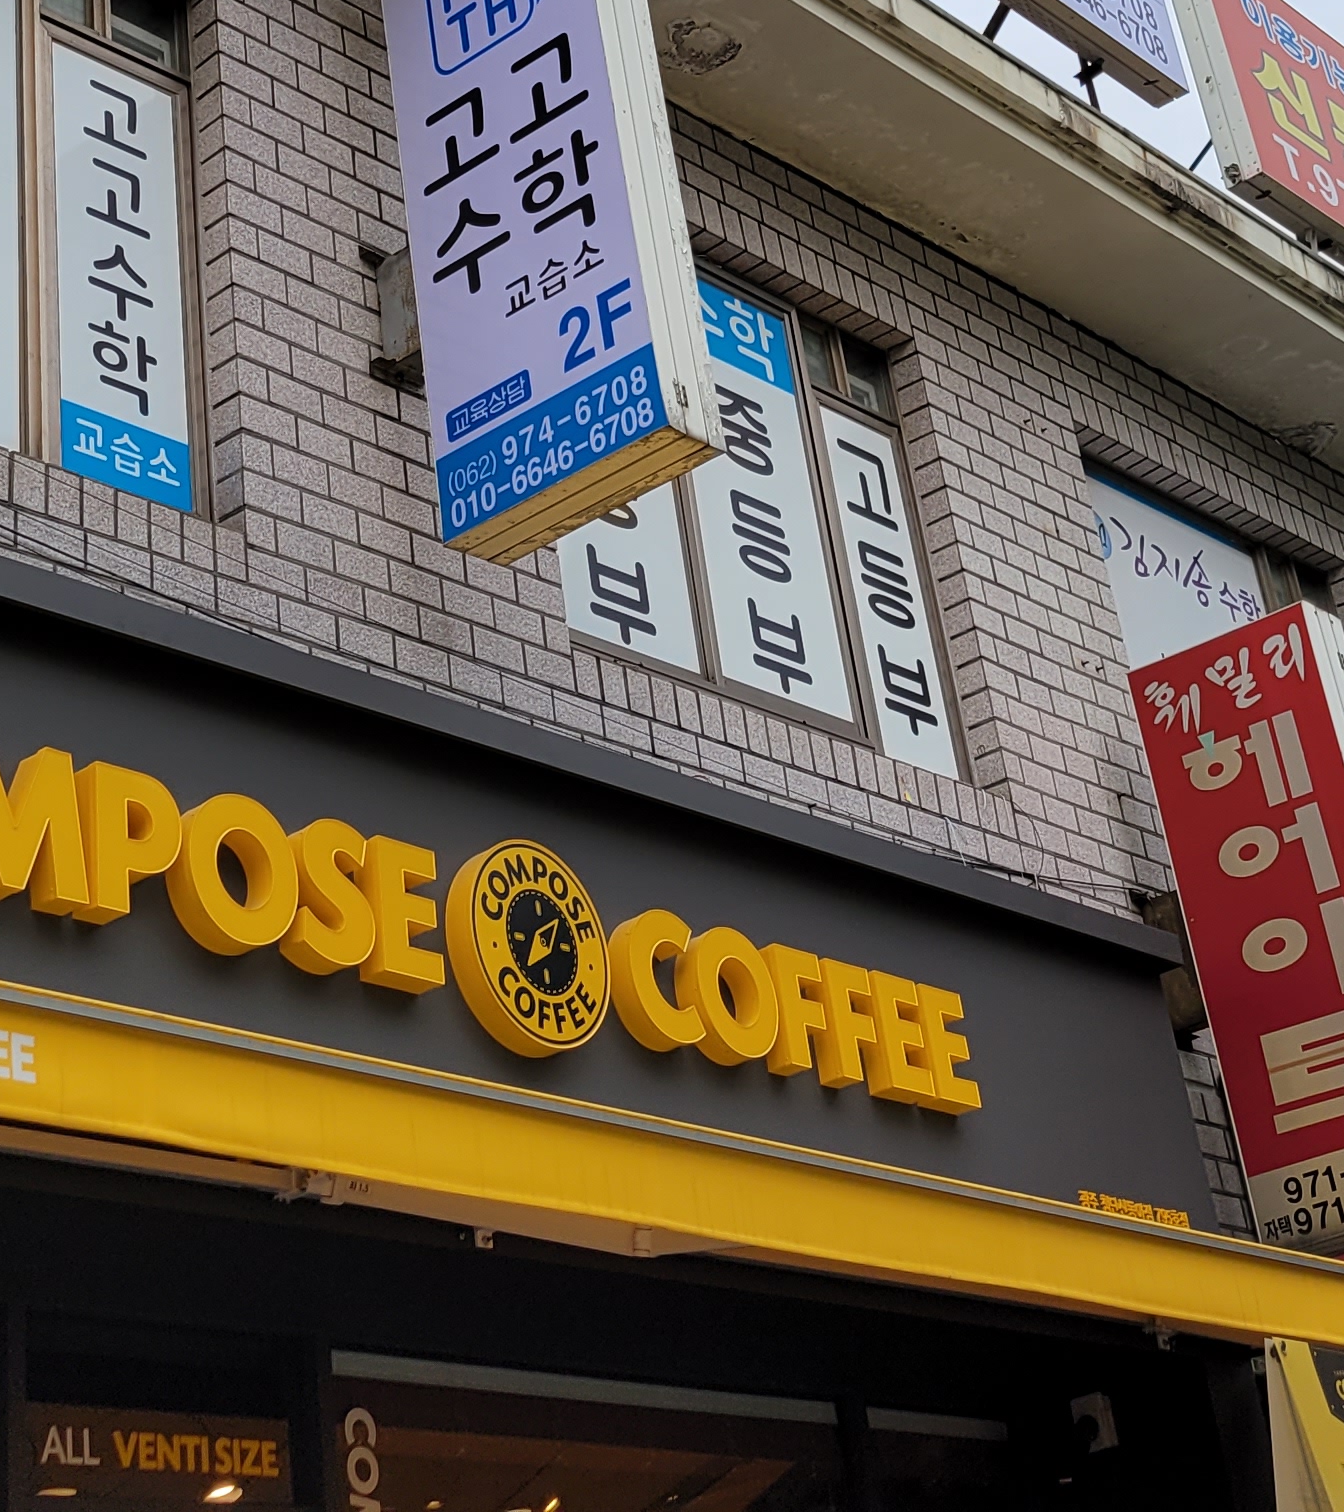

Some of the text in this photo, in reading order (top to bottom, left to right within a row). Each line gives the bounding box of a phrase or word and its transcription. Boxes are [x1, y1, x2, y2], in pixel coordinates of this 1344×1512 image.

[423, 32, 590, 197] 고고
[82, 78, 158, 418] 고고수학
[432, 128, 599, 294] 수학
[503, 240, 605, 319] 교습소
[559, 278, 632, 374] 2F
[72, 417, 182, 488] 교습소
[446, 364, 650, 498] (062) 974-6708
[450, 376, 528, 439] 교육상담
[450, 397, 655, 529] 010-6646-6708
[715, 382, 813, 695] 중등부
[836, 437, 939, 736] 고등부
[479, 857, 595, 944] COMPOSE
[497, 964, 598, 1035] COFFEE
[609, 909, 984, 1116] COFFEE
[1264, 1215, 1294, 1243] 자택
[40, 1424, 280, 1481] ALL VENTI SIZE
